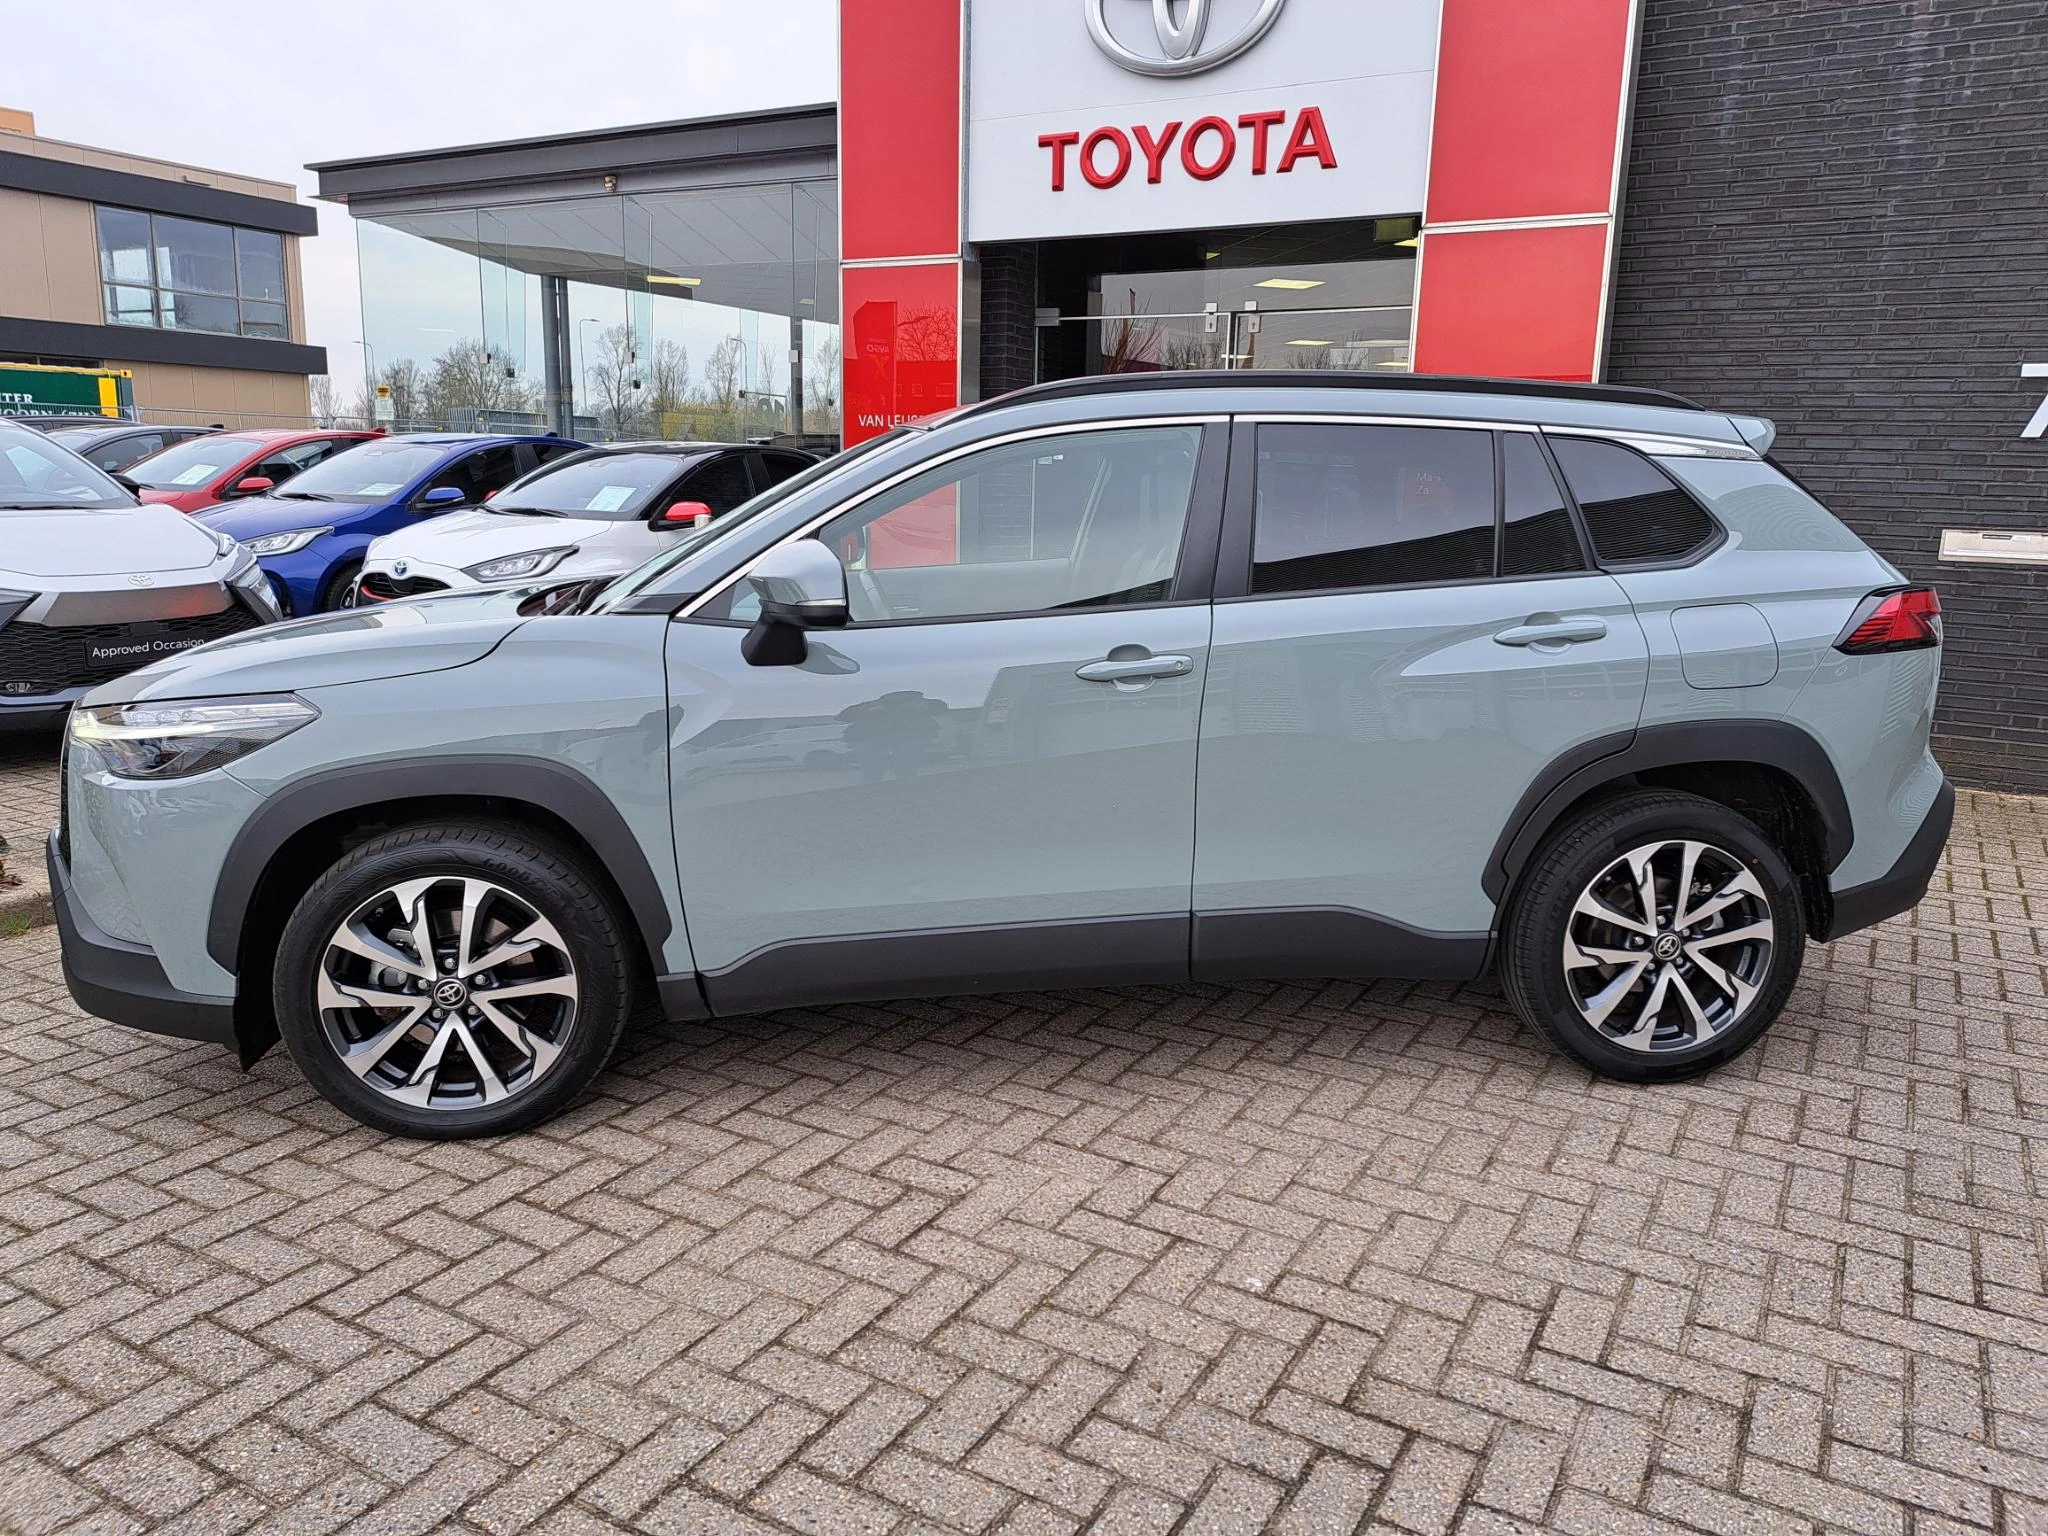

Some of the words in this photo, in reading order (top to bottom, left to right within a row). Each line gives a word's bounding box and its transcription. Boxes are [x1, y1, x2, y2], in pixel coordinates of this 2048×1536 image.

[1038, 106, 1338, 192] TOYOTA
[0, 392, 33, 404] TER
[858, 414, 884, 427] VAN
[92, 641, 150, 659] Approved
[153, 638, 205, 651] Occasion
